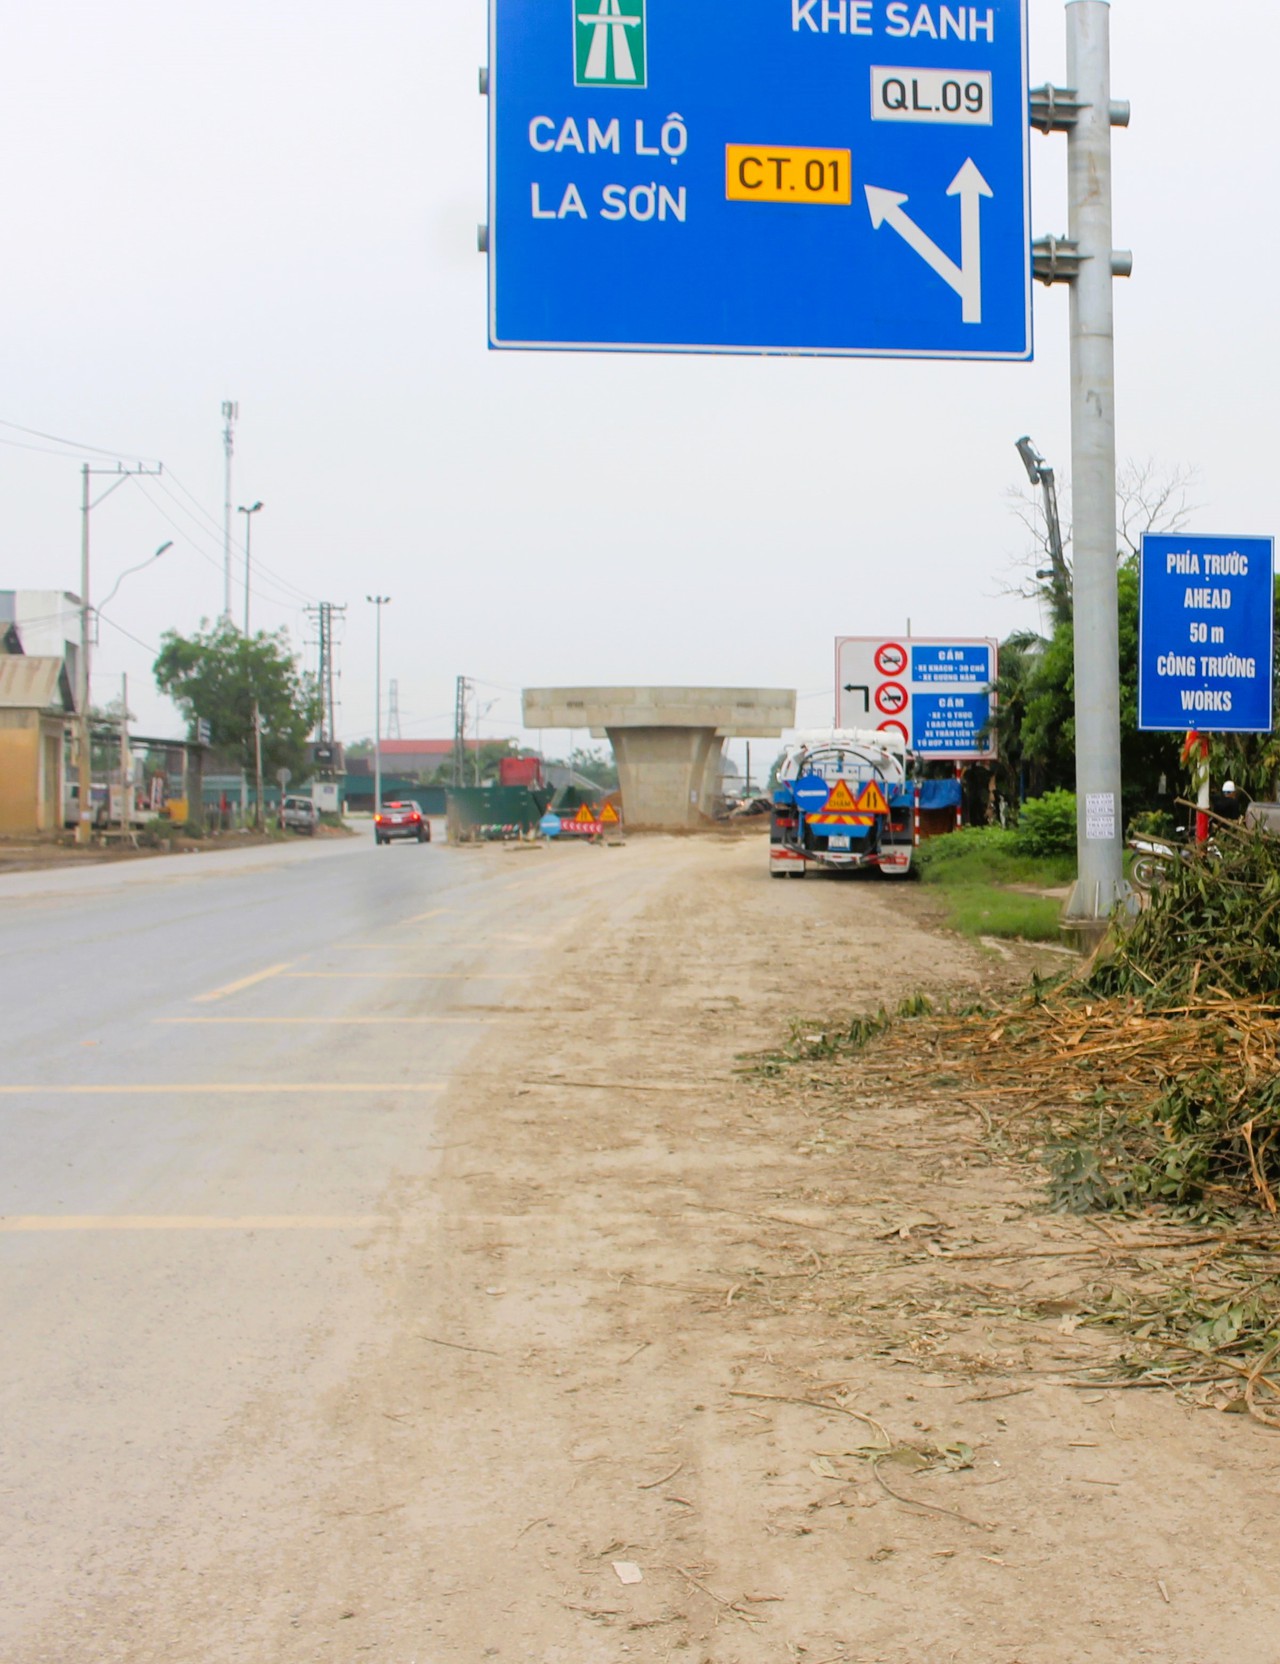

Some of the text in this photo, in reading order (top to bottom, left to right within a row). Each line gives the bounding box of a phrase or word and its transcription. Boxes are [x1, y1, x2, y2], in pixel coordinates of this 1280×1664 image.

[792, 0, 994, 43] KHE SANH
[881, 78, 983, 113] QL.09
[529, 112, 688, 165] CAM LỘ
[531, 181, 687, 222] LA SƠN
[1166, 550, 1249, 576] PHÍA TRƯỚC
[1183, 588, 1231, 609] AHEAD
[1189, 622, 1224, 643] 50 m
[1157, 652, 1256, 678] CÔNG TRƯỜNG
[1180, 690, 1232, 712] WORKS
